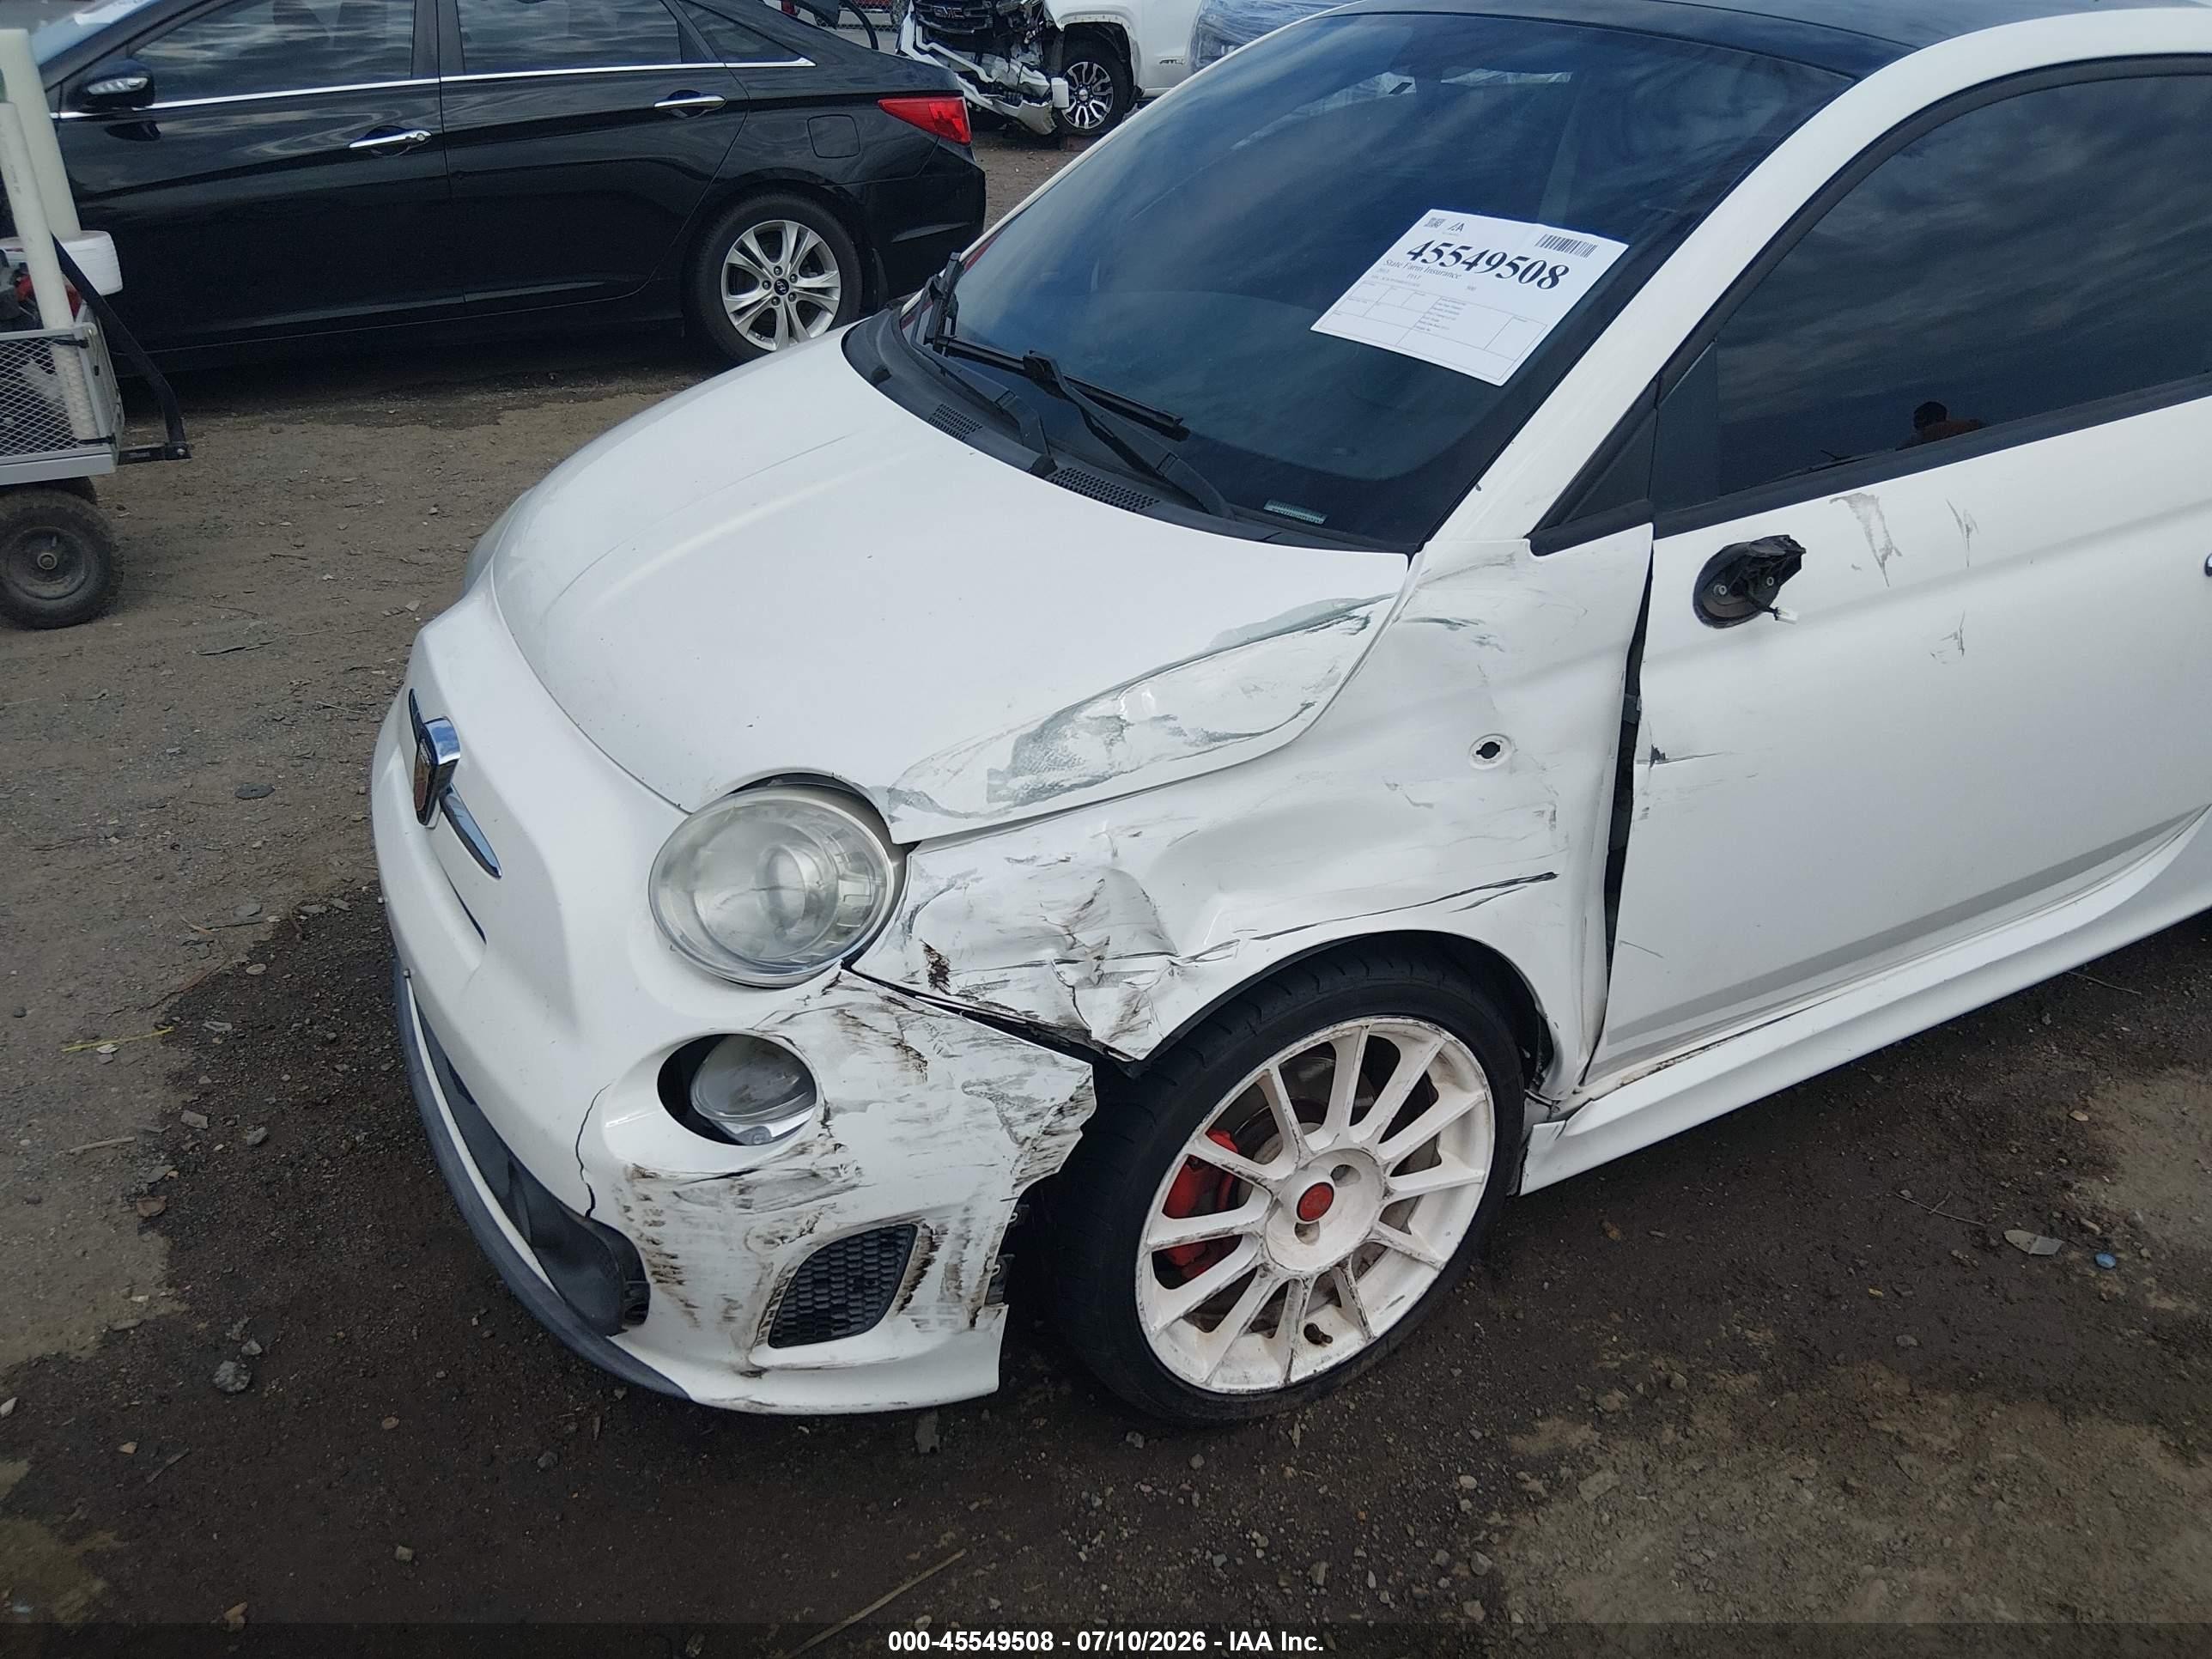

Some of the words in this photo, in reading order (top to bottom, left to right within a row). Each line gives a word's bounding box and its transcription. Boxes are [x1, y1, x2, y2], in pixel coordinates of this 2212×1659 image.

[933, 5, 964, 19] GMC
[1383, 259, 1401, 269] State
[1401, 263, 1421, 272] Farm
[1423, 266, 1462, 279] Insurance
[1407, 240, 1570, 289] 45549508
